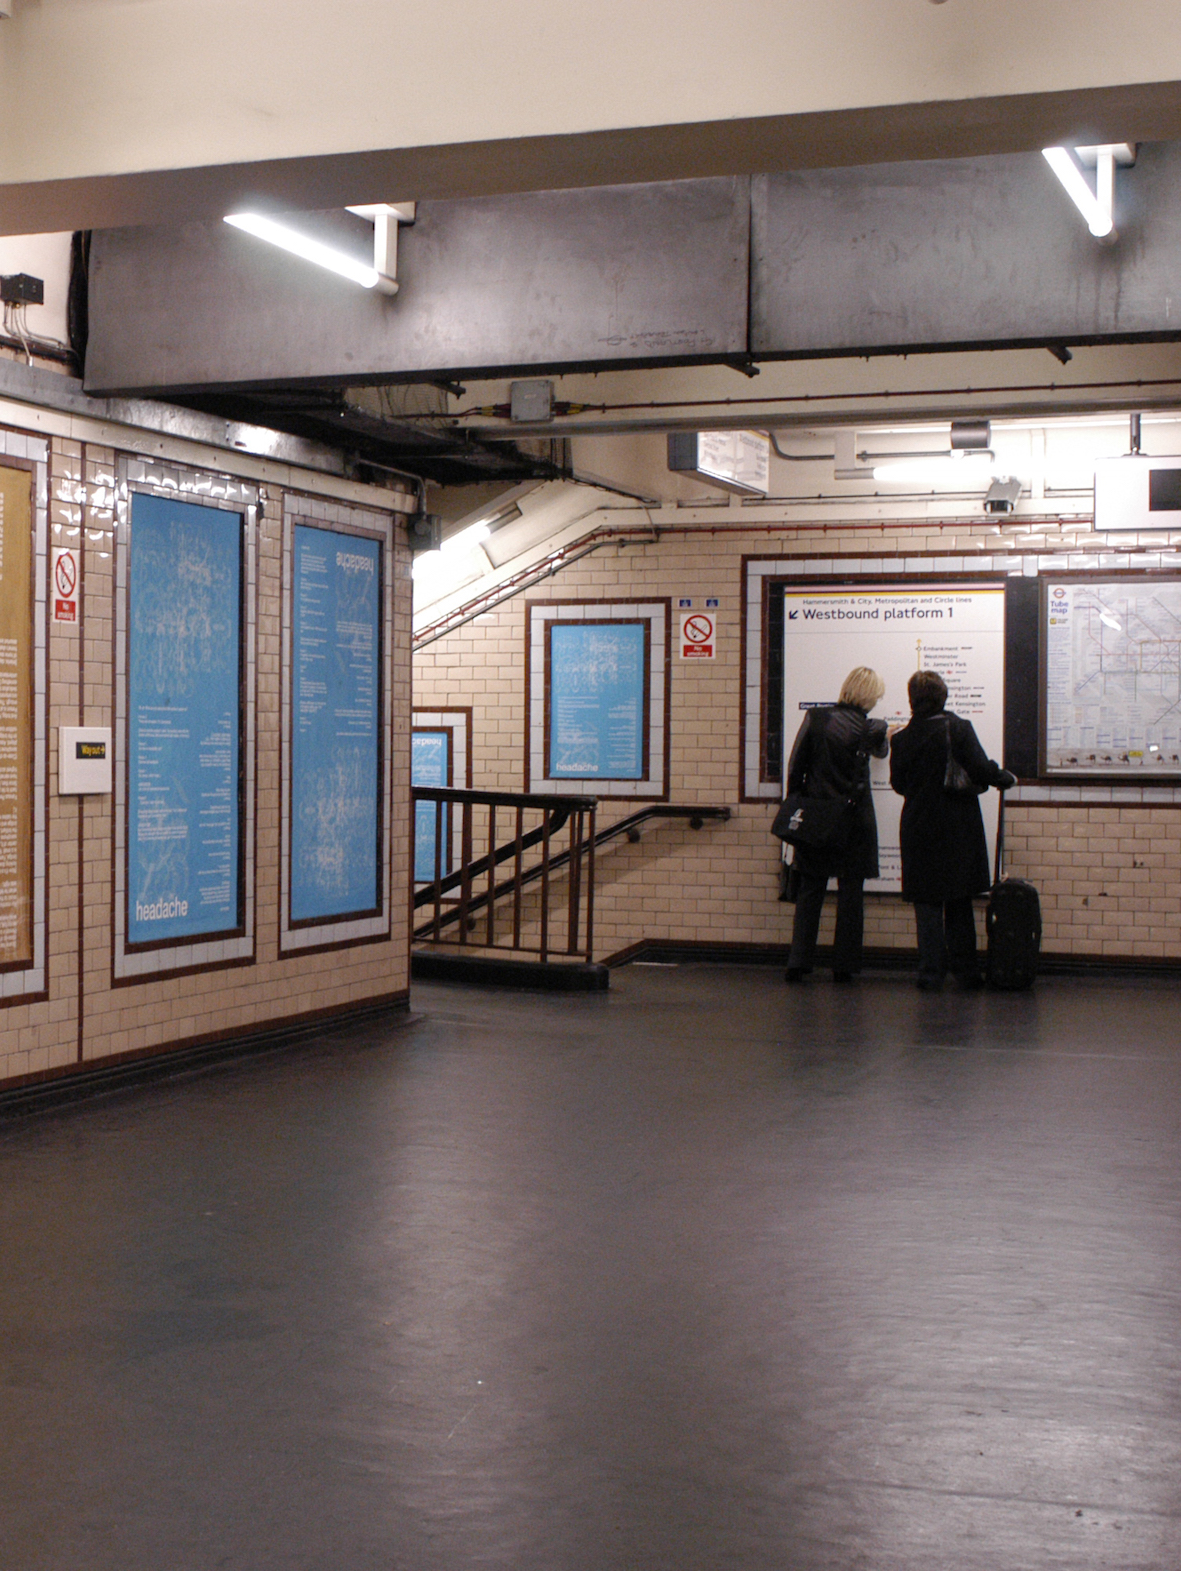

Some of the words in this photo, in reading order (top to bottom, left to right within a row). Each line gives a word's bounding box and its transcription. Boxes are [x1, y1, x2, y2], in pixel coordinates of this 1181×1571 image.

[336, 551, 374, 576] headache
[802, 598, 849, 606] Hammersmith
[875, 596, 919, 605] Metropolitan
[934, 596, 955, 604] Circle
[802, 608, 879, 620] Westbound
[883, 606, 943, 622] platform
[947, 606, 954, 618] 1
[412, 738, 441, 746] headac
[556, 762, 598, 772] headache
[136, 895, 188, 922] headache
